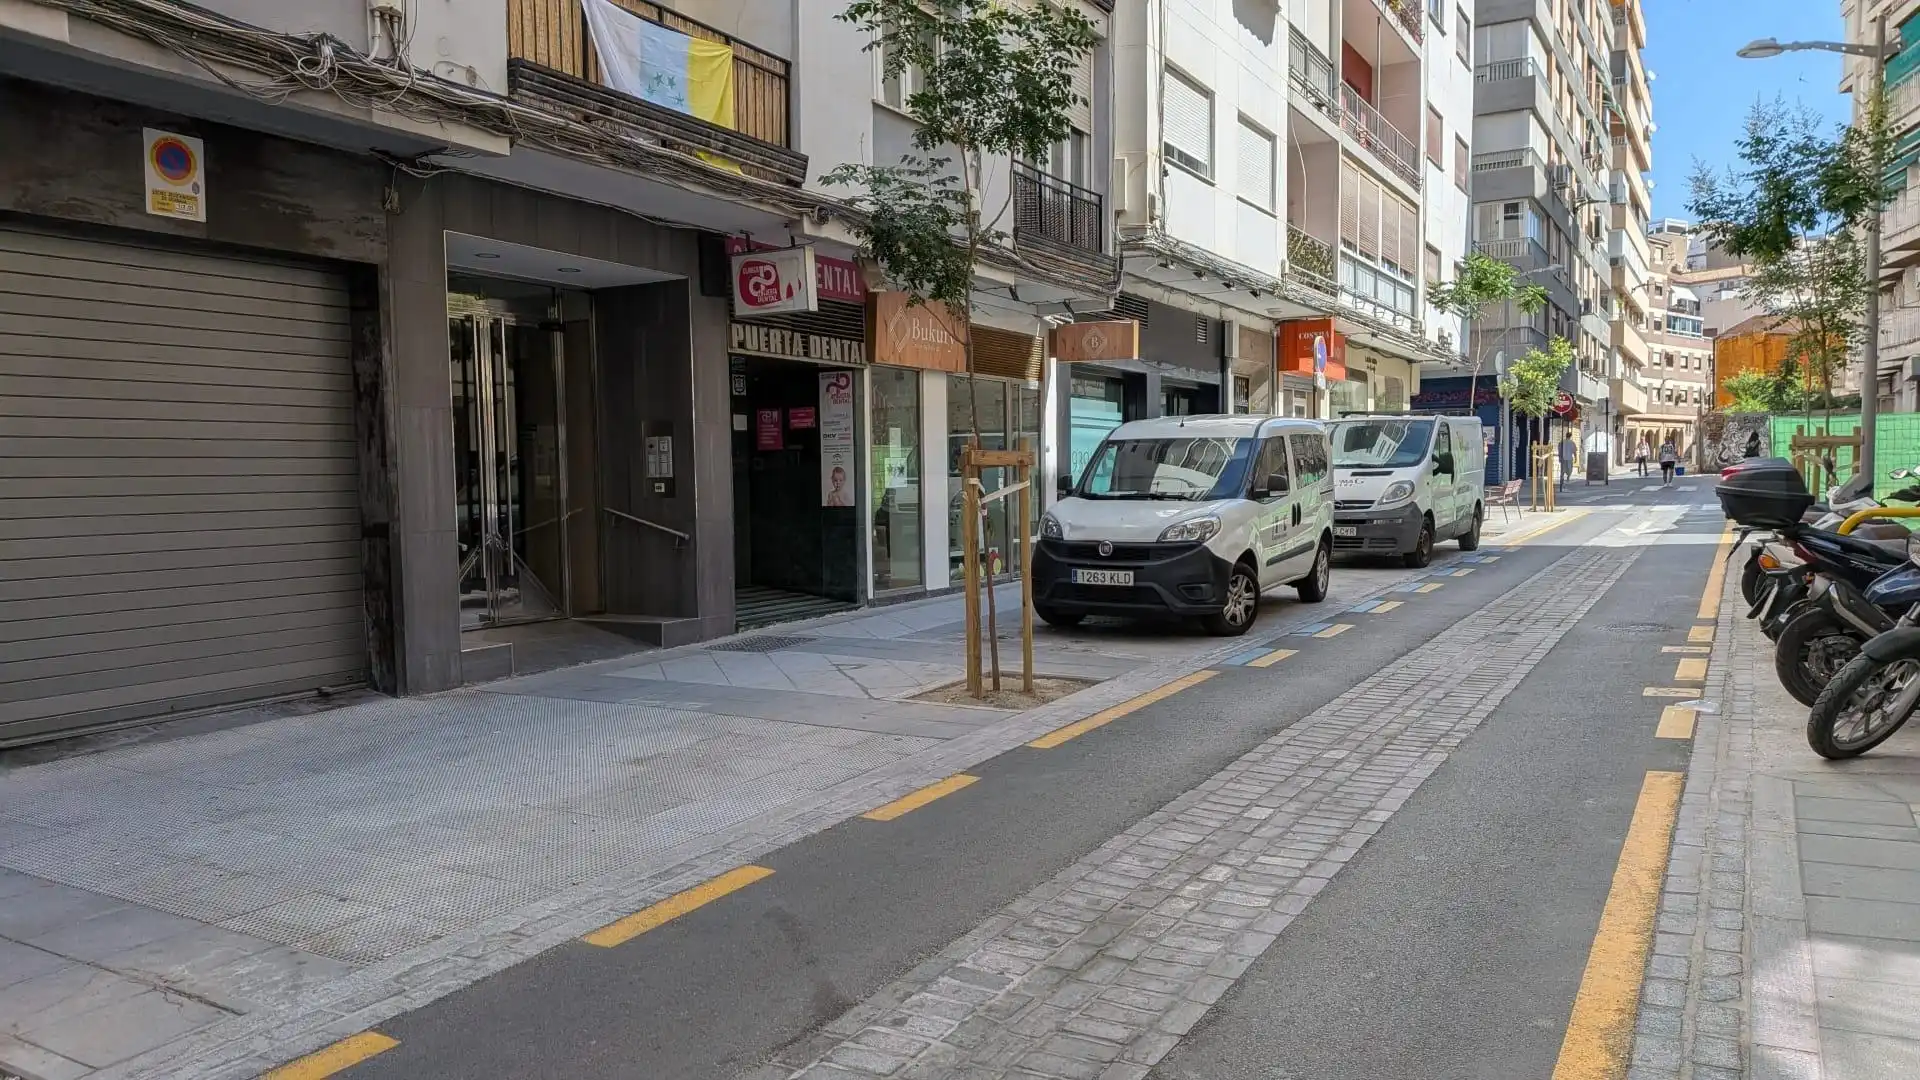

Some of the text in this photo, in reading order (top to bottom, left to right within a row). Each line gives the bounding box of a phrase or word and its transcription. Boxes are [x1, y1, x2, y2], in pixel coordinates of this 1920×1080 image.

[816, 263, 860, 296] ENTAL
[731, 323, 804, 356] PUERTA
[1091, 336, 1099, 348] B
[1081, 571, 1131, 585] 1263 KLD
